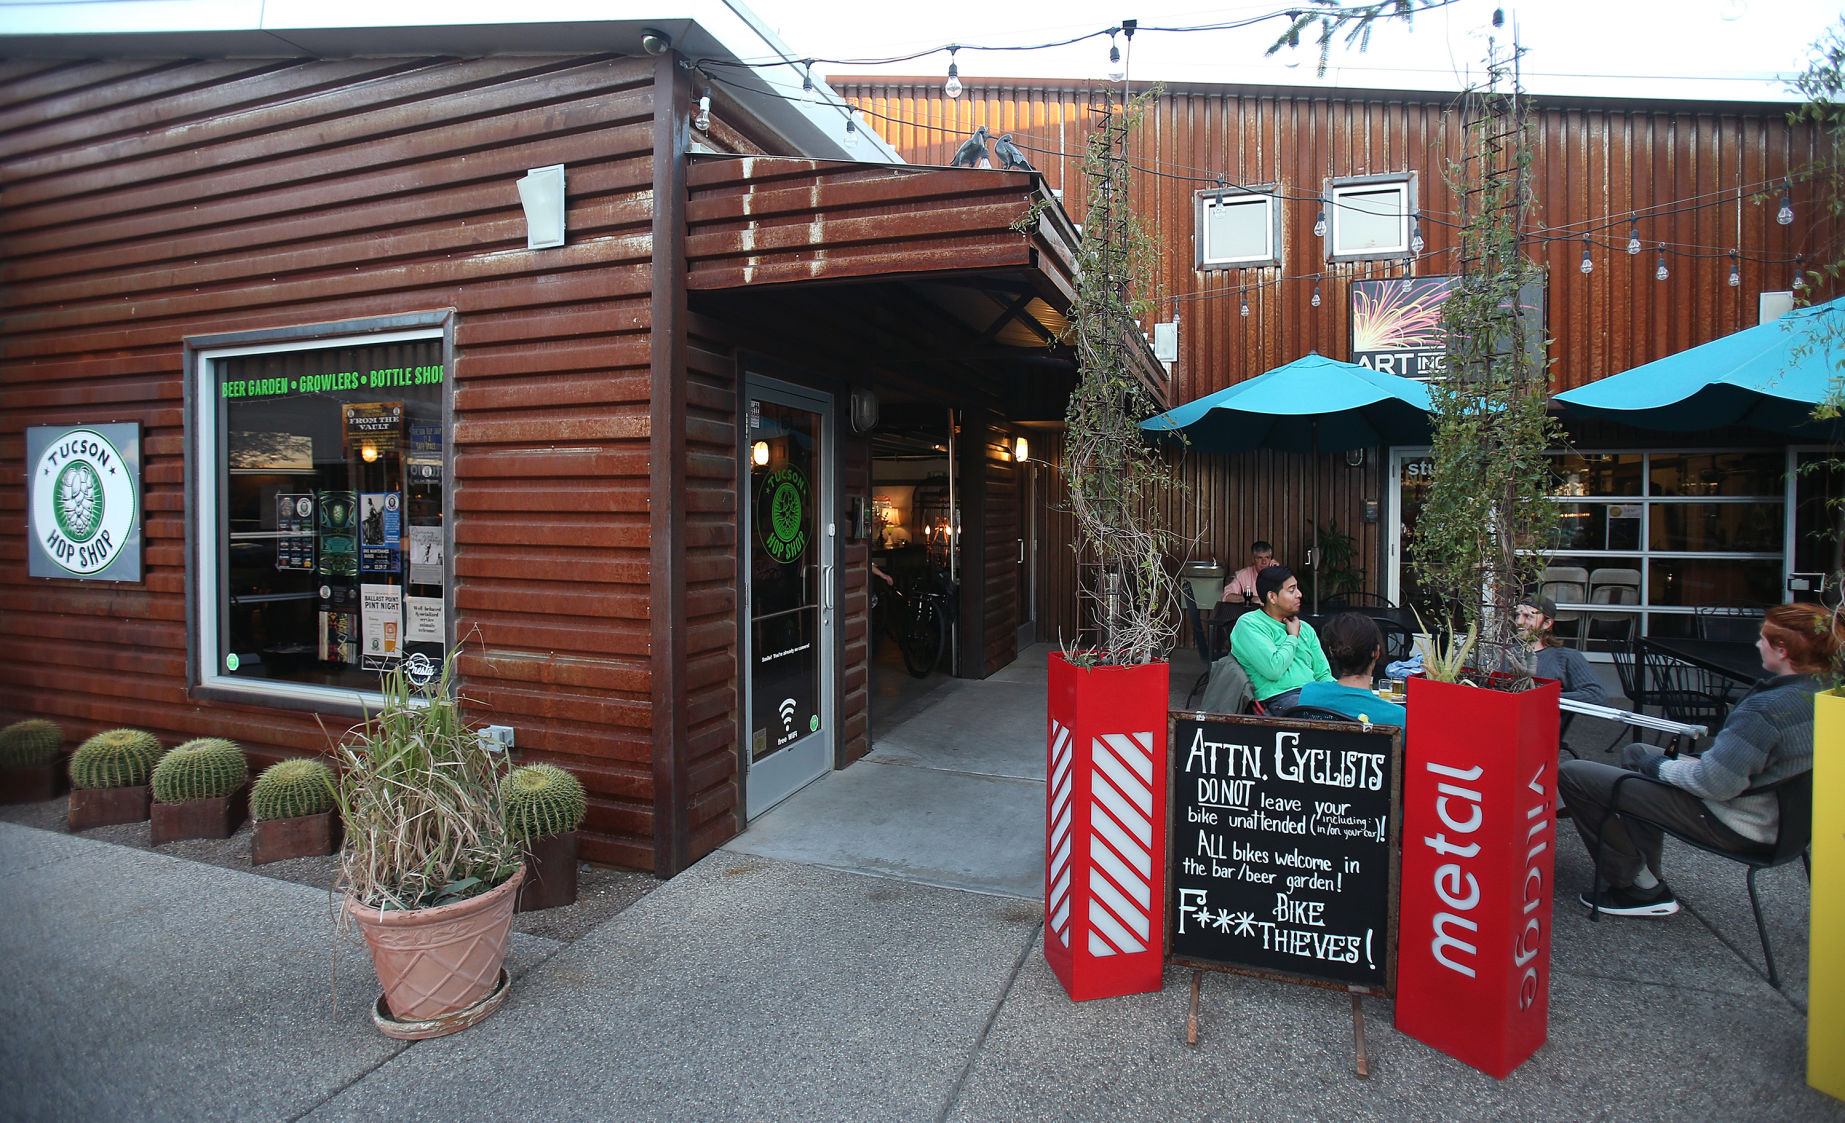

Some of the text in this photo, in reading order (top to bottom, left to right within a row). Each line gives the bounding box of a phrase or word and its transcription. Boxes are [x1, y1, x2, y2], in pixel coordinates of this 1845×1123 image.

[1358, 353, 1415, 375] ART
[221, 381, 246, 398] BEER
[248, 378, 288, 396] GARDEN
[300, 372, 359, 392] GROWLERS
[370, 367, 412, 388] BOTTLE
[48, 440, 111, 467] TUCSON
[768, 469, 805, 490] TUCSON
[46, 530, 113, 568] HOP SHOP
[766, 530, 805, 560] HOP SHOP
[380, 602, 399, 610] NIGHT
[777, 736, 788, 746] free
[1185, 728, 1268, 781] ATTN.
[1198, 778, 1351, 819] DO NOT leave your
[1188, 806, 1306, 835] bike unattended
[1343, 828, 1362, 840] your
[1198, 829, 1360, 874] ALL bikes welcome in
[1183, 858, 1207, 876] the
[1286, 872, 1343, 894] garden!
[1424, 761, 1484, 979] metal
[1514, 763, 1549, 1012] village
[1272, 893, 1326, 927] BIKE
[1258, 922, 1376, 970] THIEVES!
